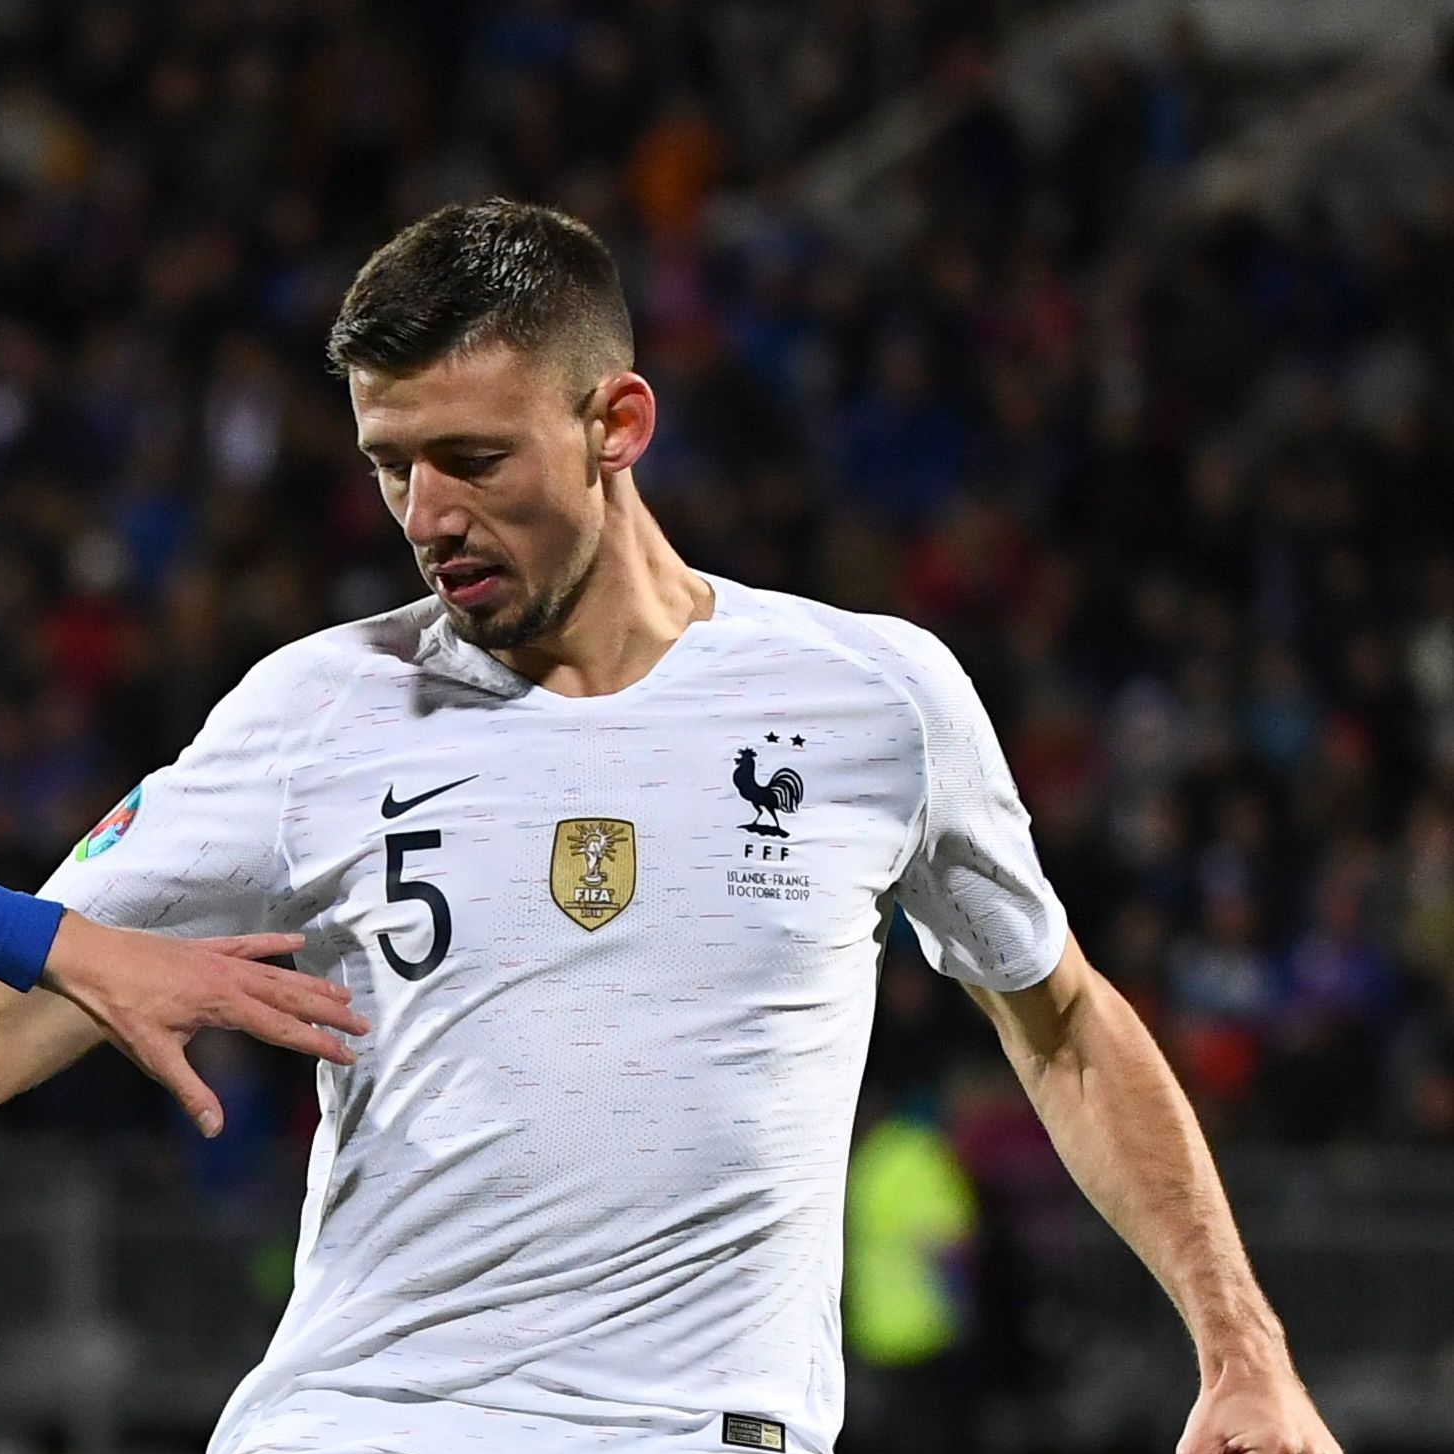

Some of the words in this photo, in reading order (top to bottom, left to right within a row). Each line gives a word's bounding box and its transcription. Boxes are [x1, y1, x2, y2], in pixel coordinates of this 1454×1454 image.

[574, 888, 612, 903] FIFA
[784, 889, 811, 901] 2019
[377, 829, 452, 982] 5
